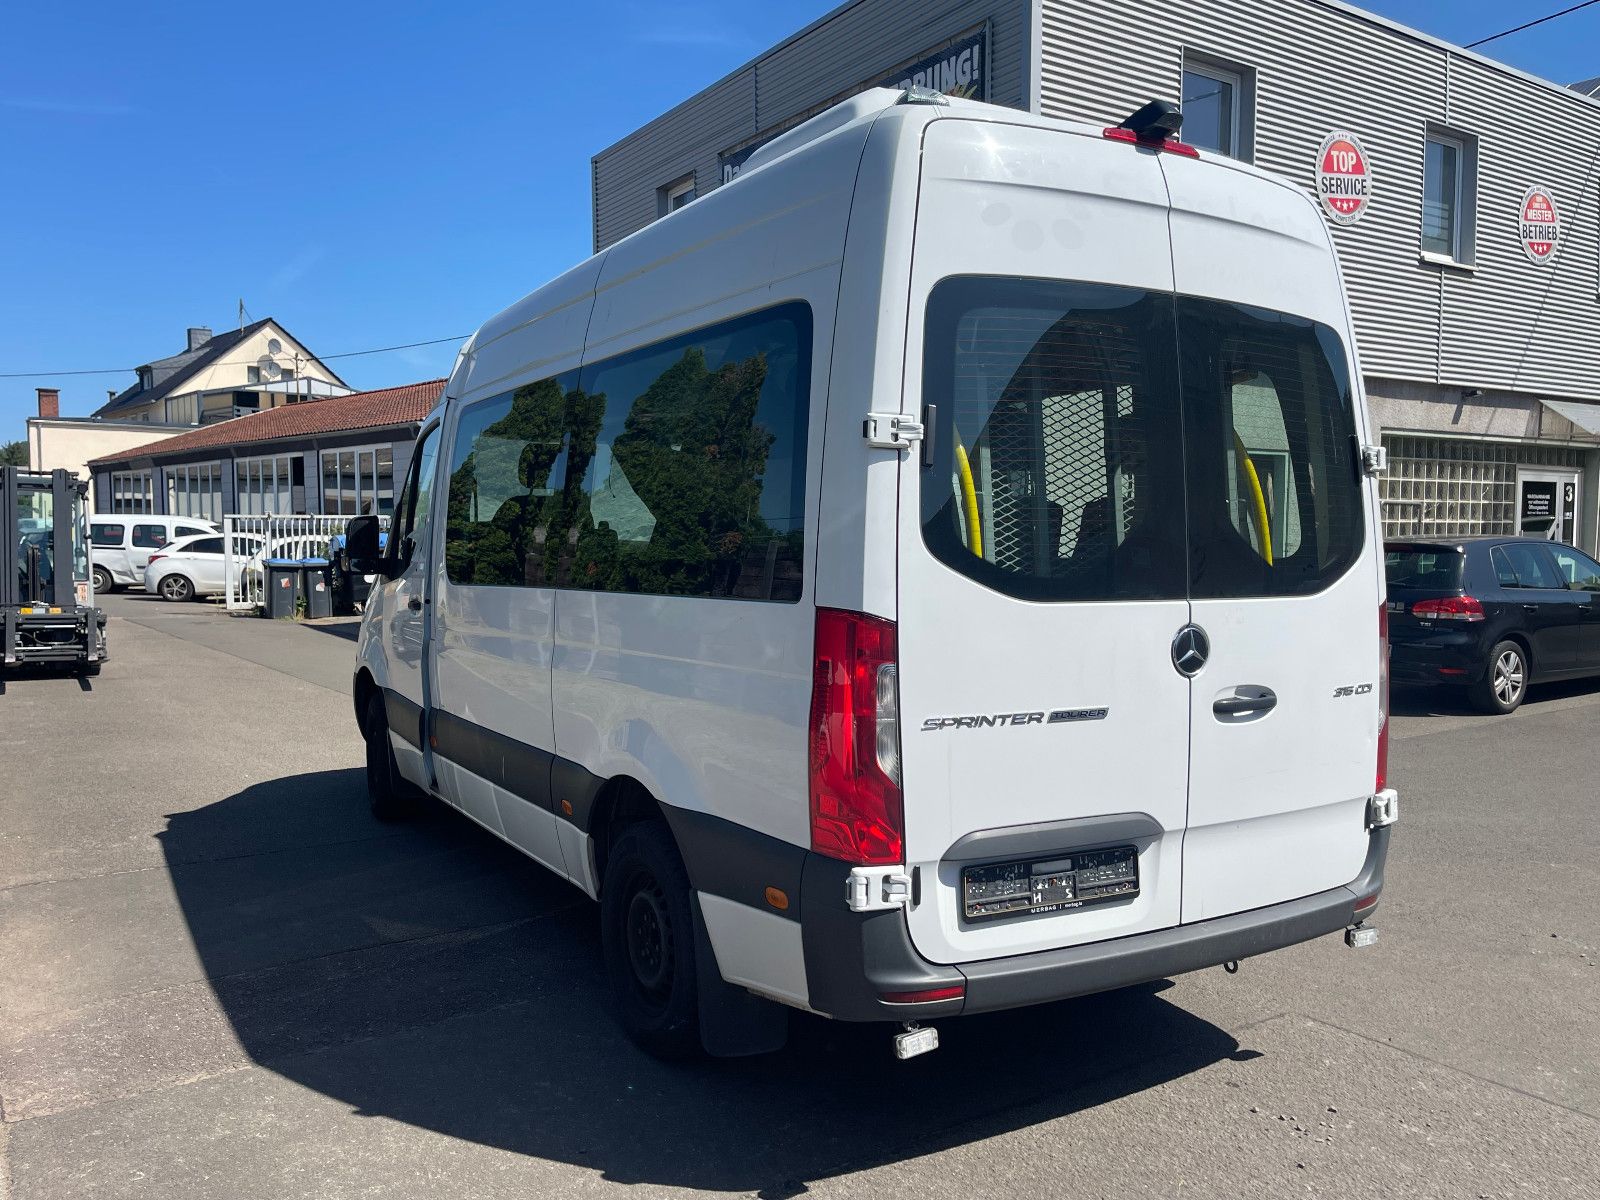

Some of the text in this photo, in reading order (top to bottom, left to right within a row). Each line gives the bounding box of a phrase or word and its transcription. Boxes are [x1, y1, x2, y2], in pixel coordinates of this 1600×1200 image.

[1330, 150, 1357, 173] TOP
[1321, 176, 1368, 196] SERVICE
[1527, 208, 1553, 221] MEISTER
[1522, 223, 1558, 240] BETRIEB
[1565, 485, 1573, 502] 3
[921, 708, 1109, 731] SPRINTER TOURER
